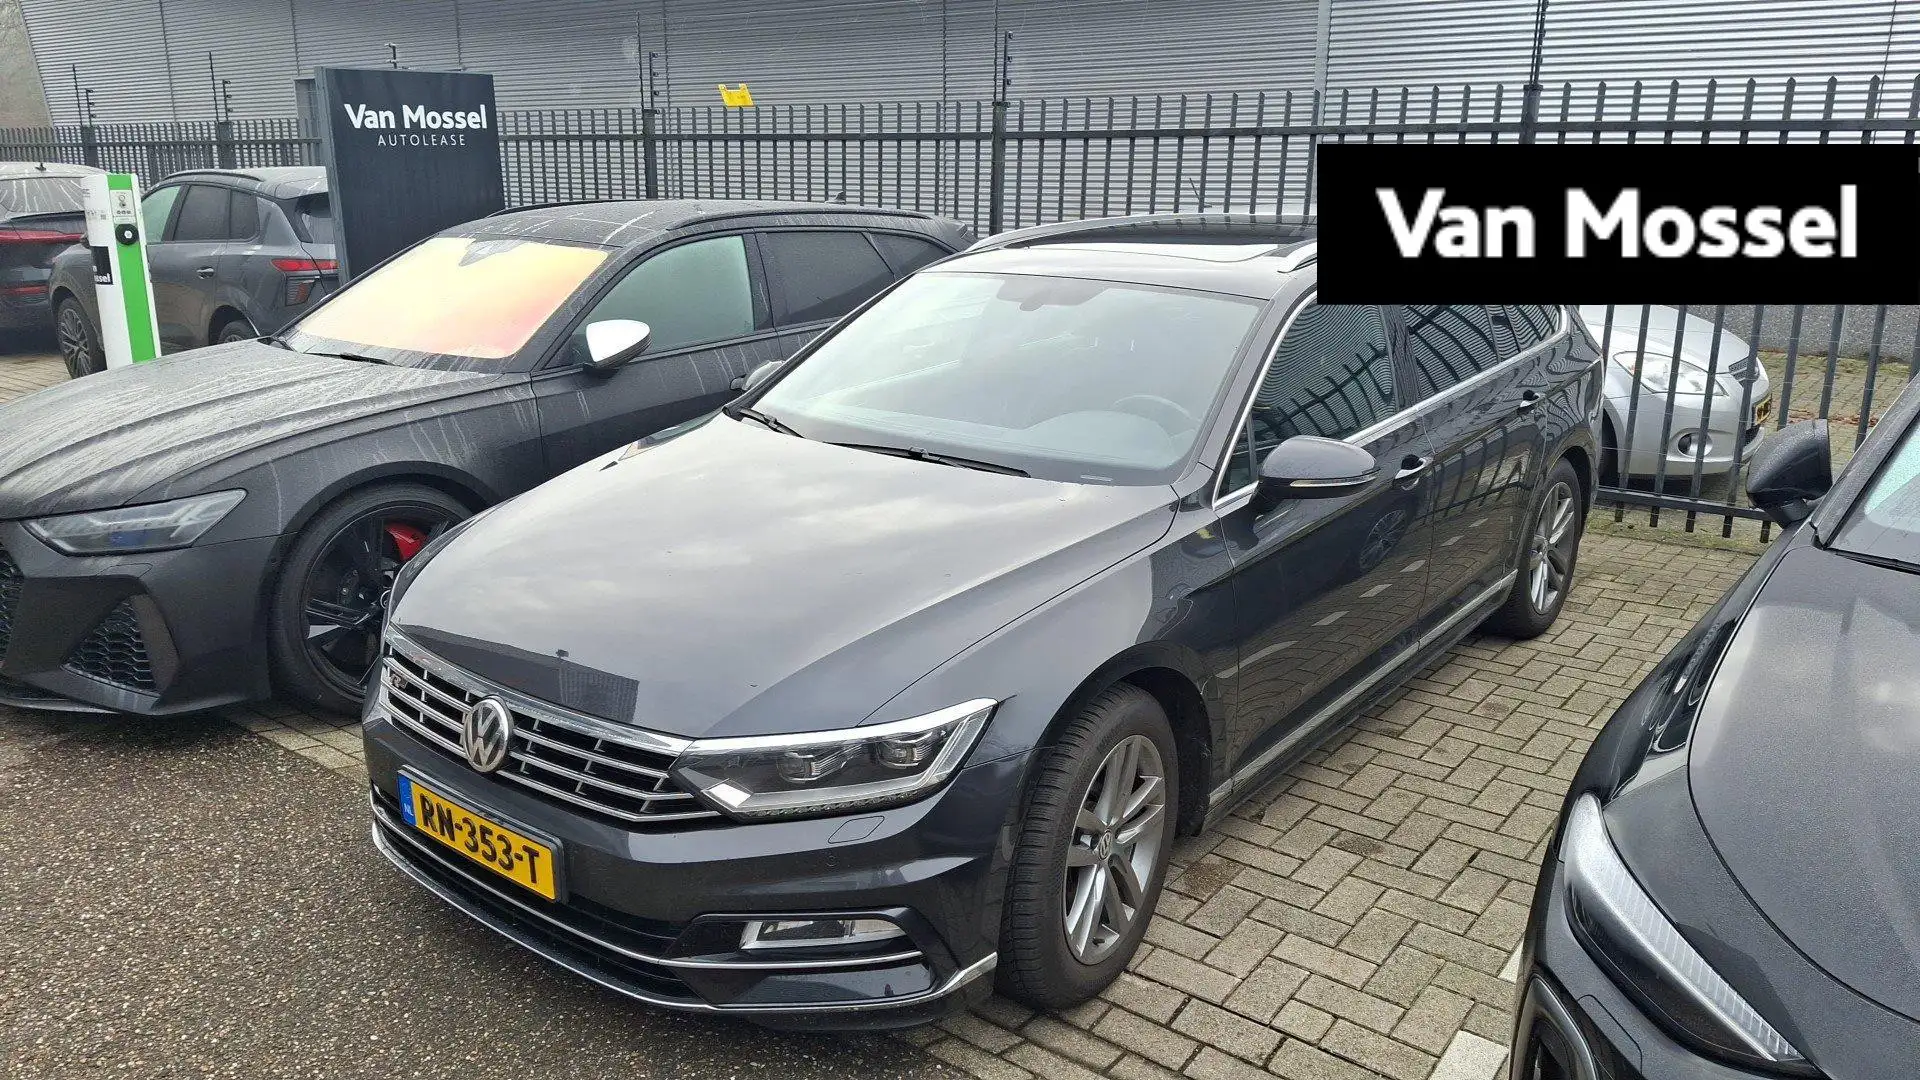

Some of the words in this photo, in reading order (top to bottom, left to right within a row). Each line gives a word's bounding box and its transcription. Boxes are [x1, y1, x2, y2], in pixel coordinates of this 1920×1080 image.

[343, 103, 396, 129] Van
[402, 104, 488, 129] Mossel
[377, 134, 466, 147] AUTOLEASE
[419, 792, 541, 885] RN-353-T
